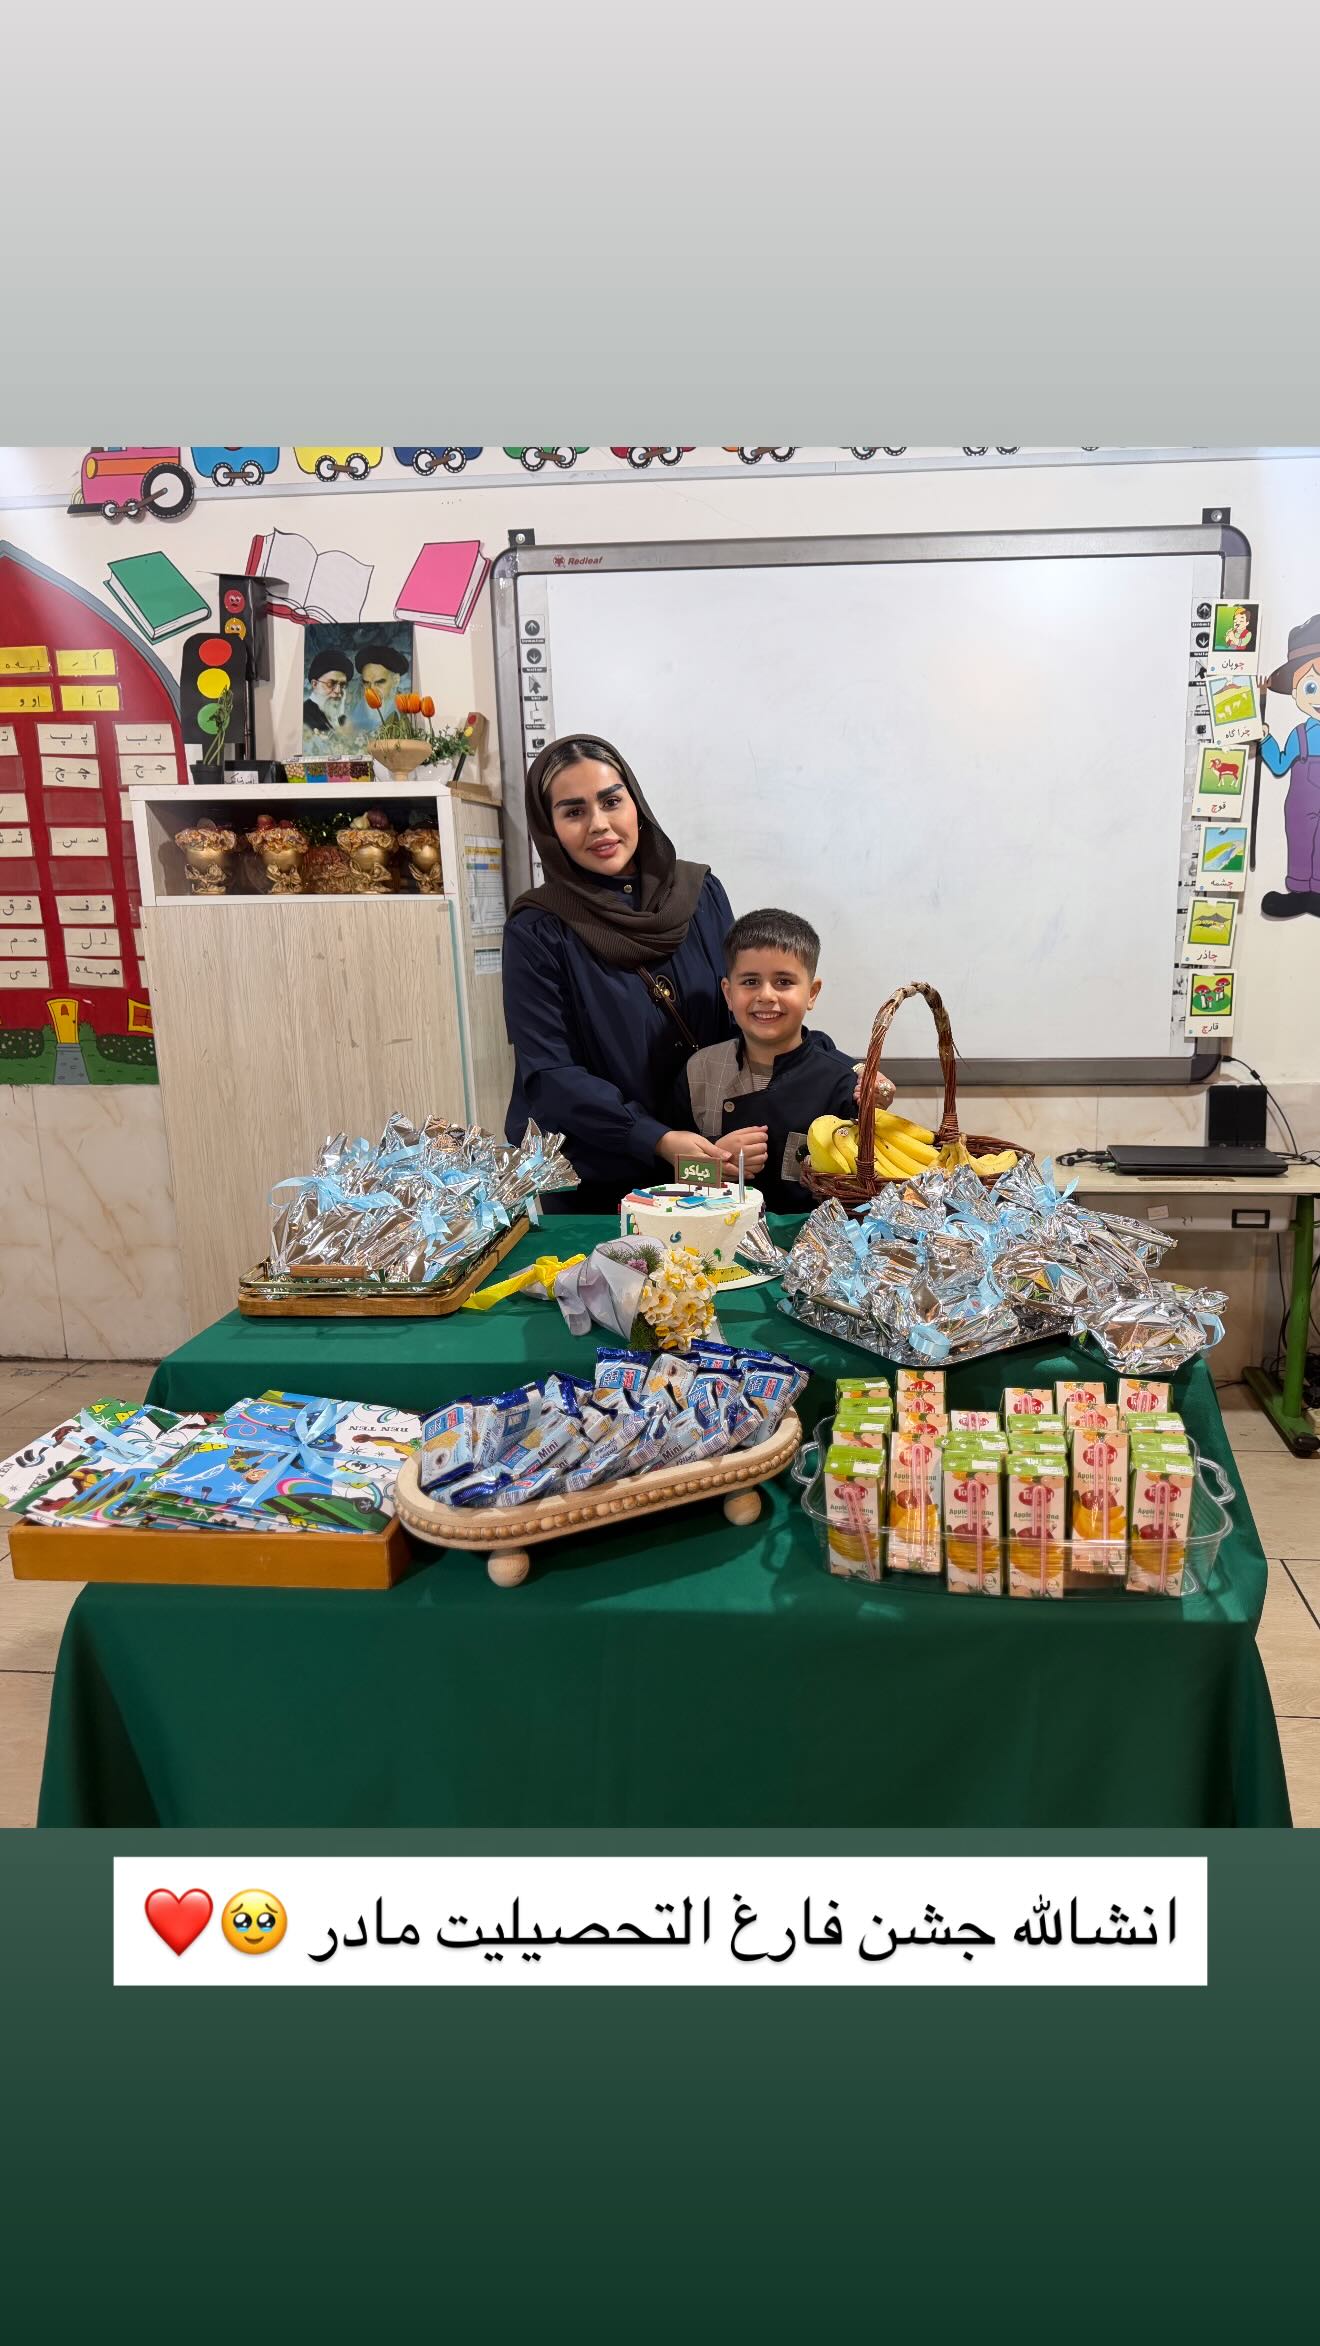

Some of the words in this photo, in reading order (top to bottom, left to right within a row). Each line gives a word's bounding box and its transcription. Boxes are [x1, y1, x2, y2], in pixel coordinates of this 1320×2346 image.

[568, 557, 603, 566] Redleaf
[1201, 1022, 1219, 1034] قارچ
[681, 1164, 711, 1181] دیاکو
[538, 1439, 559, 1459] Mini
[661, 1443, 683, 1460] Mini
